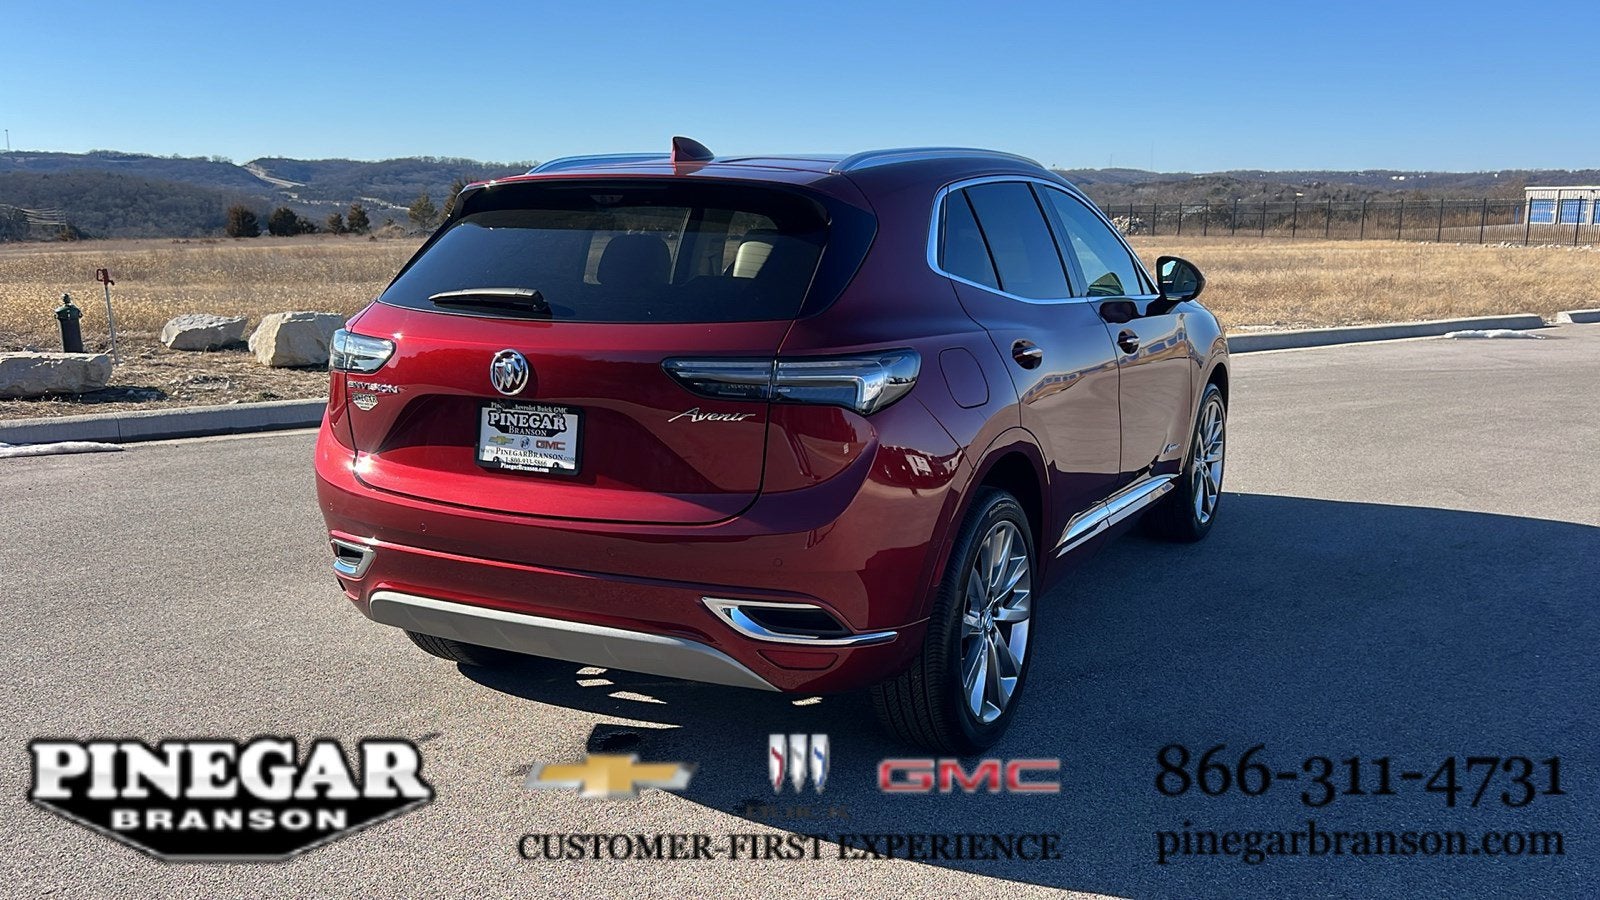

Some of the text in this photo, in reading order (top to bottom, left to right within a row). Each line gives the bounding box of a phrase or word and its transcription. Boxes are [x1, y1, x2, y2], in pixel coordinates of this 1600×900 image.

[489, 412, 566, 431] PINEGAR
[667, 407, 756, 423] Avenir
[535, 440, 566, 451] GMC
